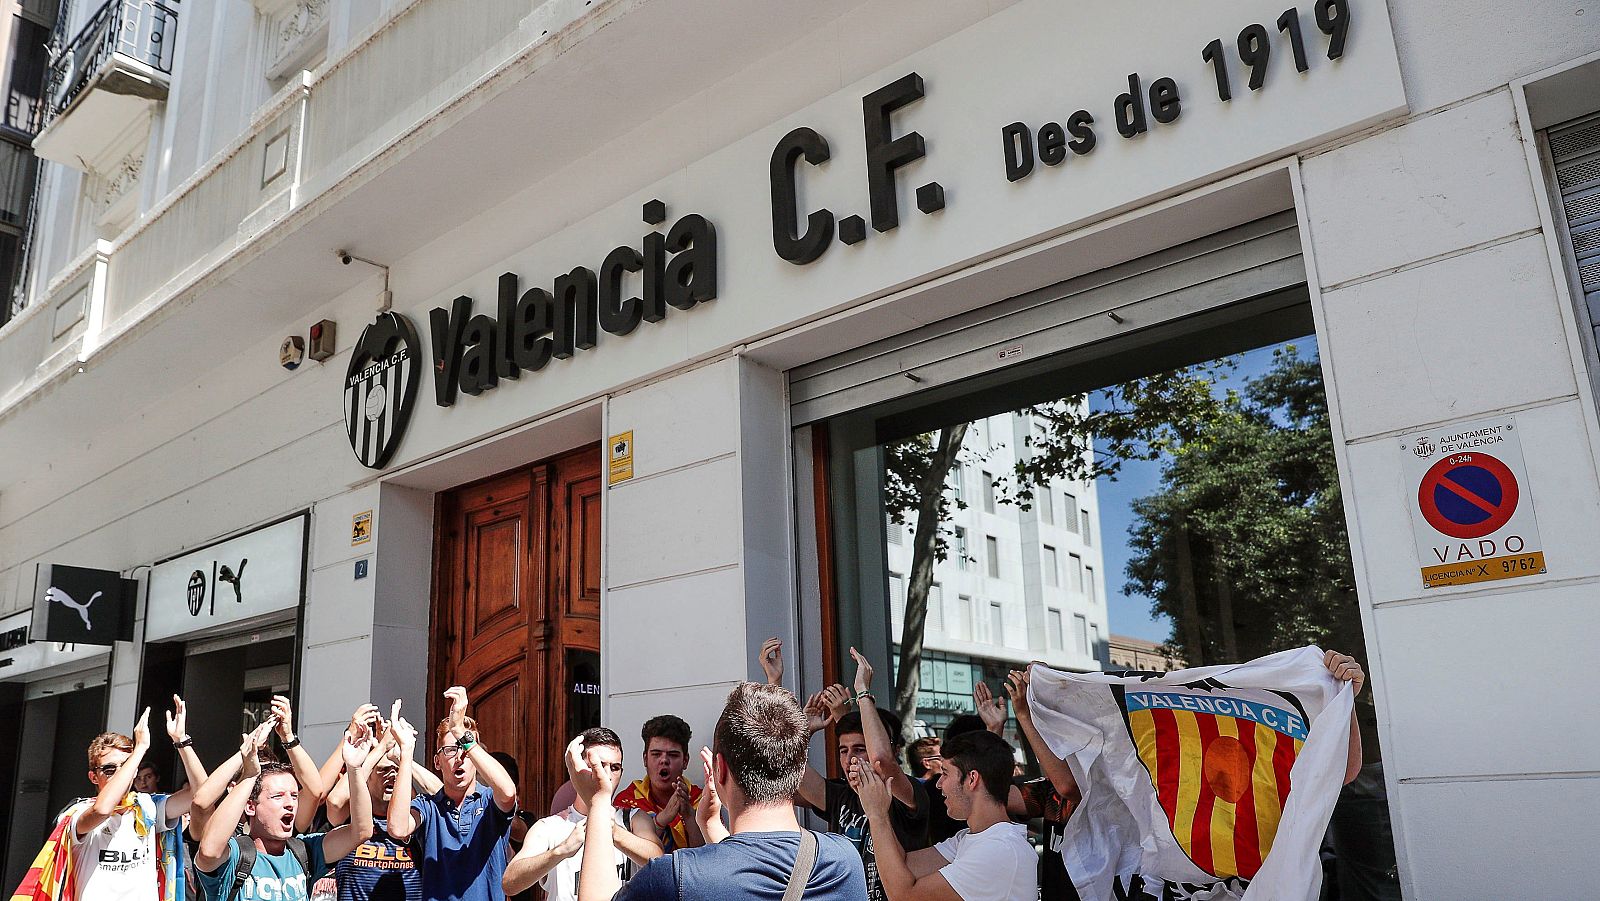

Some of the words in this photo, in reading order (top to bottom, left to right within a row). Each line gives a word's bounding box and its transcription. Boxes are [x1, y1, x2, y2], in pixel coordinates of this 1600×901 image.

[429, 199, 717, 407] Valencia
[770, 72, 945, 265] C.F.
[1002, 109, 1097, 183] Des
[1113, 73, 1182, 139] de
[1202, 0, 1352, 102] 1919
[350, 359, 390, 386] VALENCIA
[391, 350, 407, 365] C.F.
[1440, 426, 1503, 445] AJUNTAMENT
[1441, 445, 1455, 453] DE
[1449, 454, 1472, 466] 0-24h
[1433, 535, 1525, 563] VADO
[1424, 570, 1465, 582] LICENCIA
[1477, 564, 1490, 576] X
[1502, 557, 1537, 573] 9762
[573, 683, 600, 695] ALEN
[1131, 693, 1259, 721] VALENCIA
[1261, 707, 1309, 740] C.F.
[353, 858, 414, 870] smartphones
